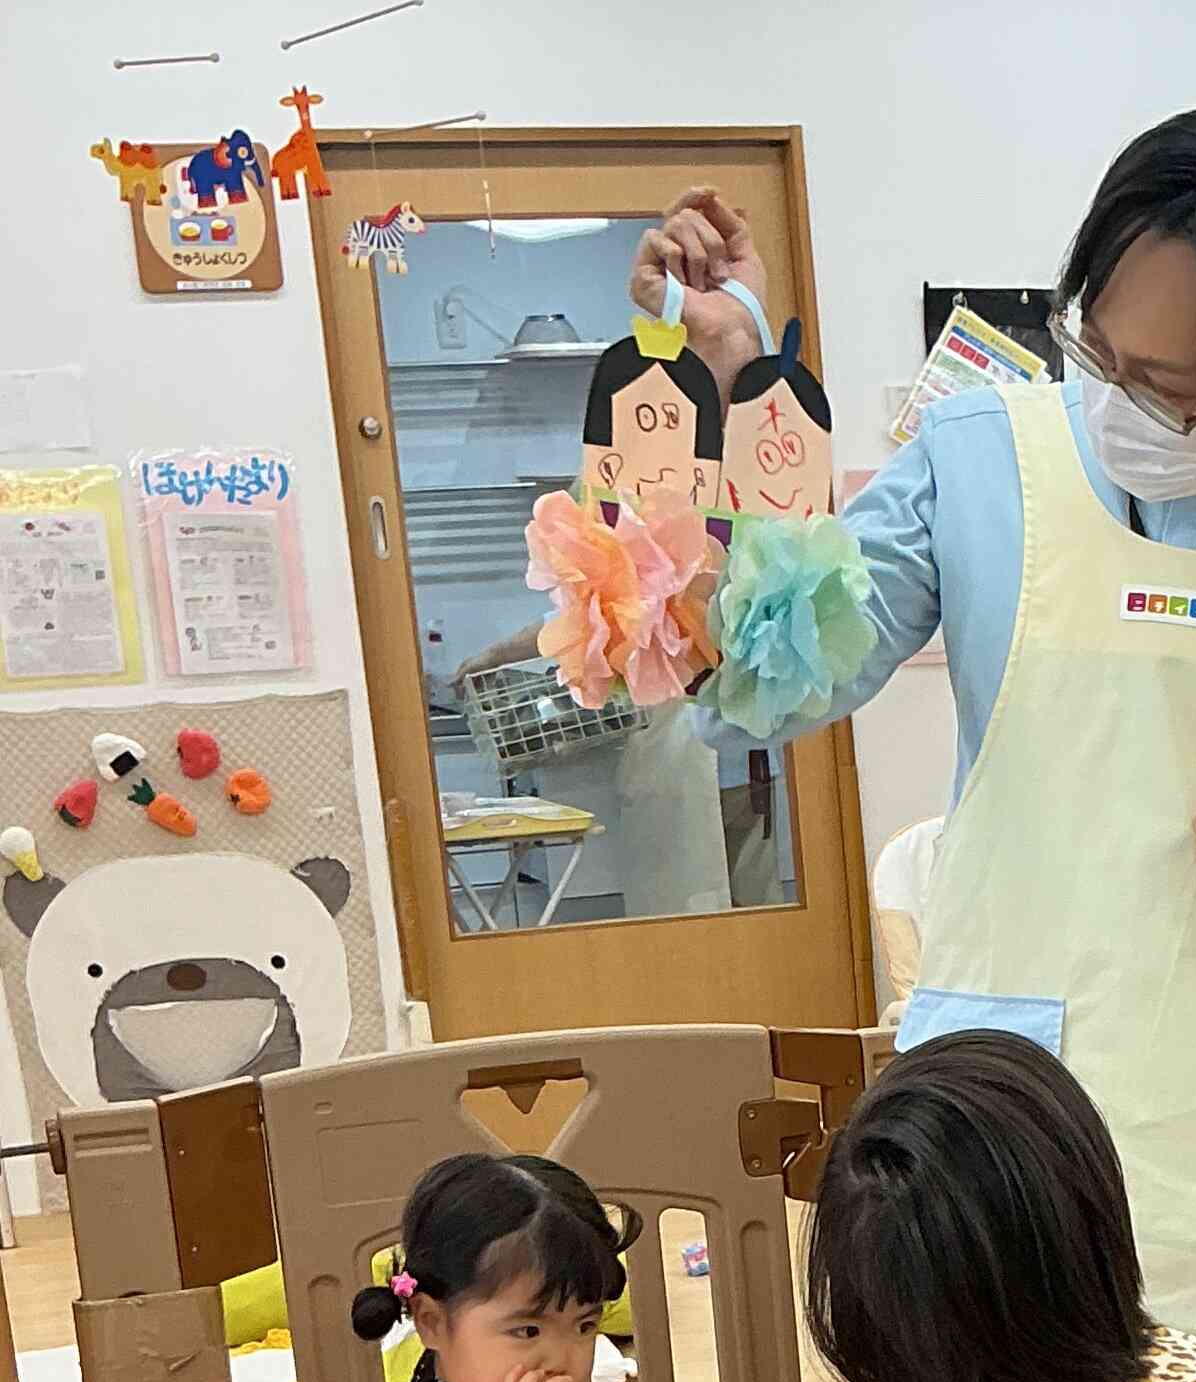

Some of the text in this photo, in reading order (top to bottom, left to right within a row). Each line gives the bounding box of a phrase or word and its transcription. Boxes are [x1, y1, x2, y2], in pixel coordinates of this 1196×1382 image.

[172, 251, 248, 266] きゅうしょくしつ
[142, 456, 289, 506] ほけんだより
